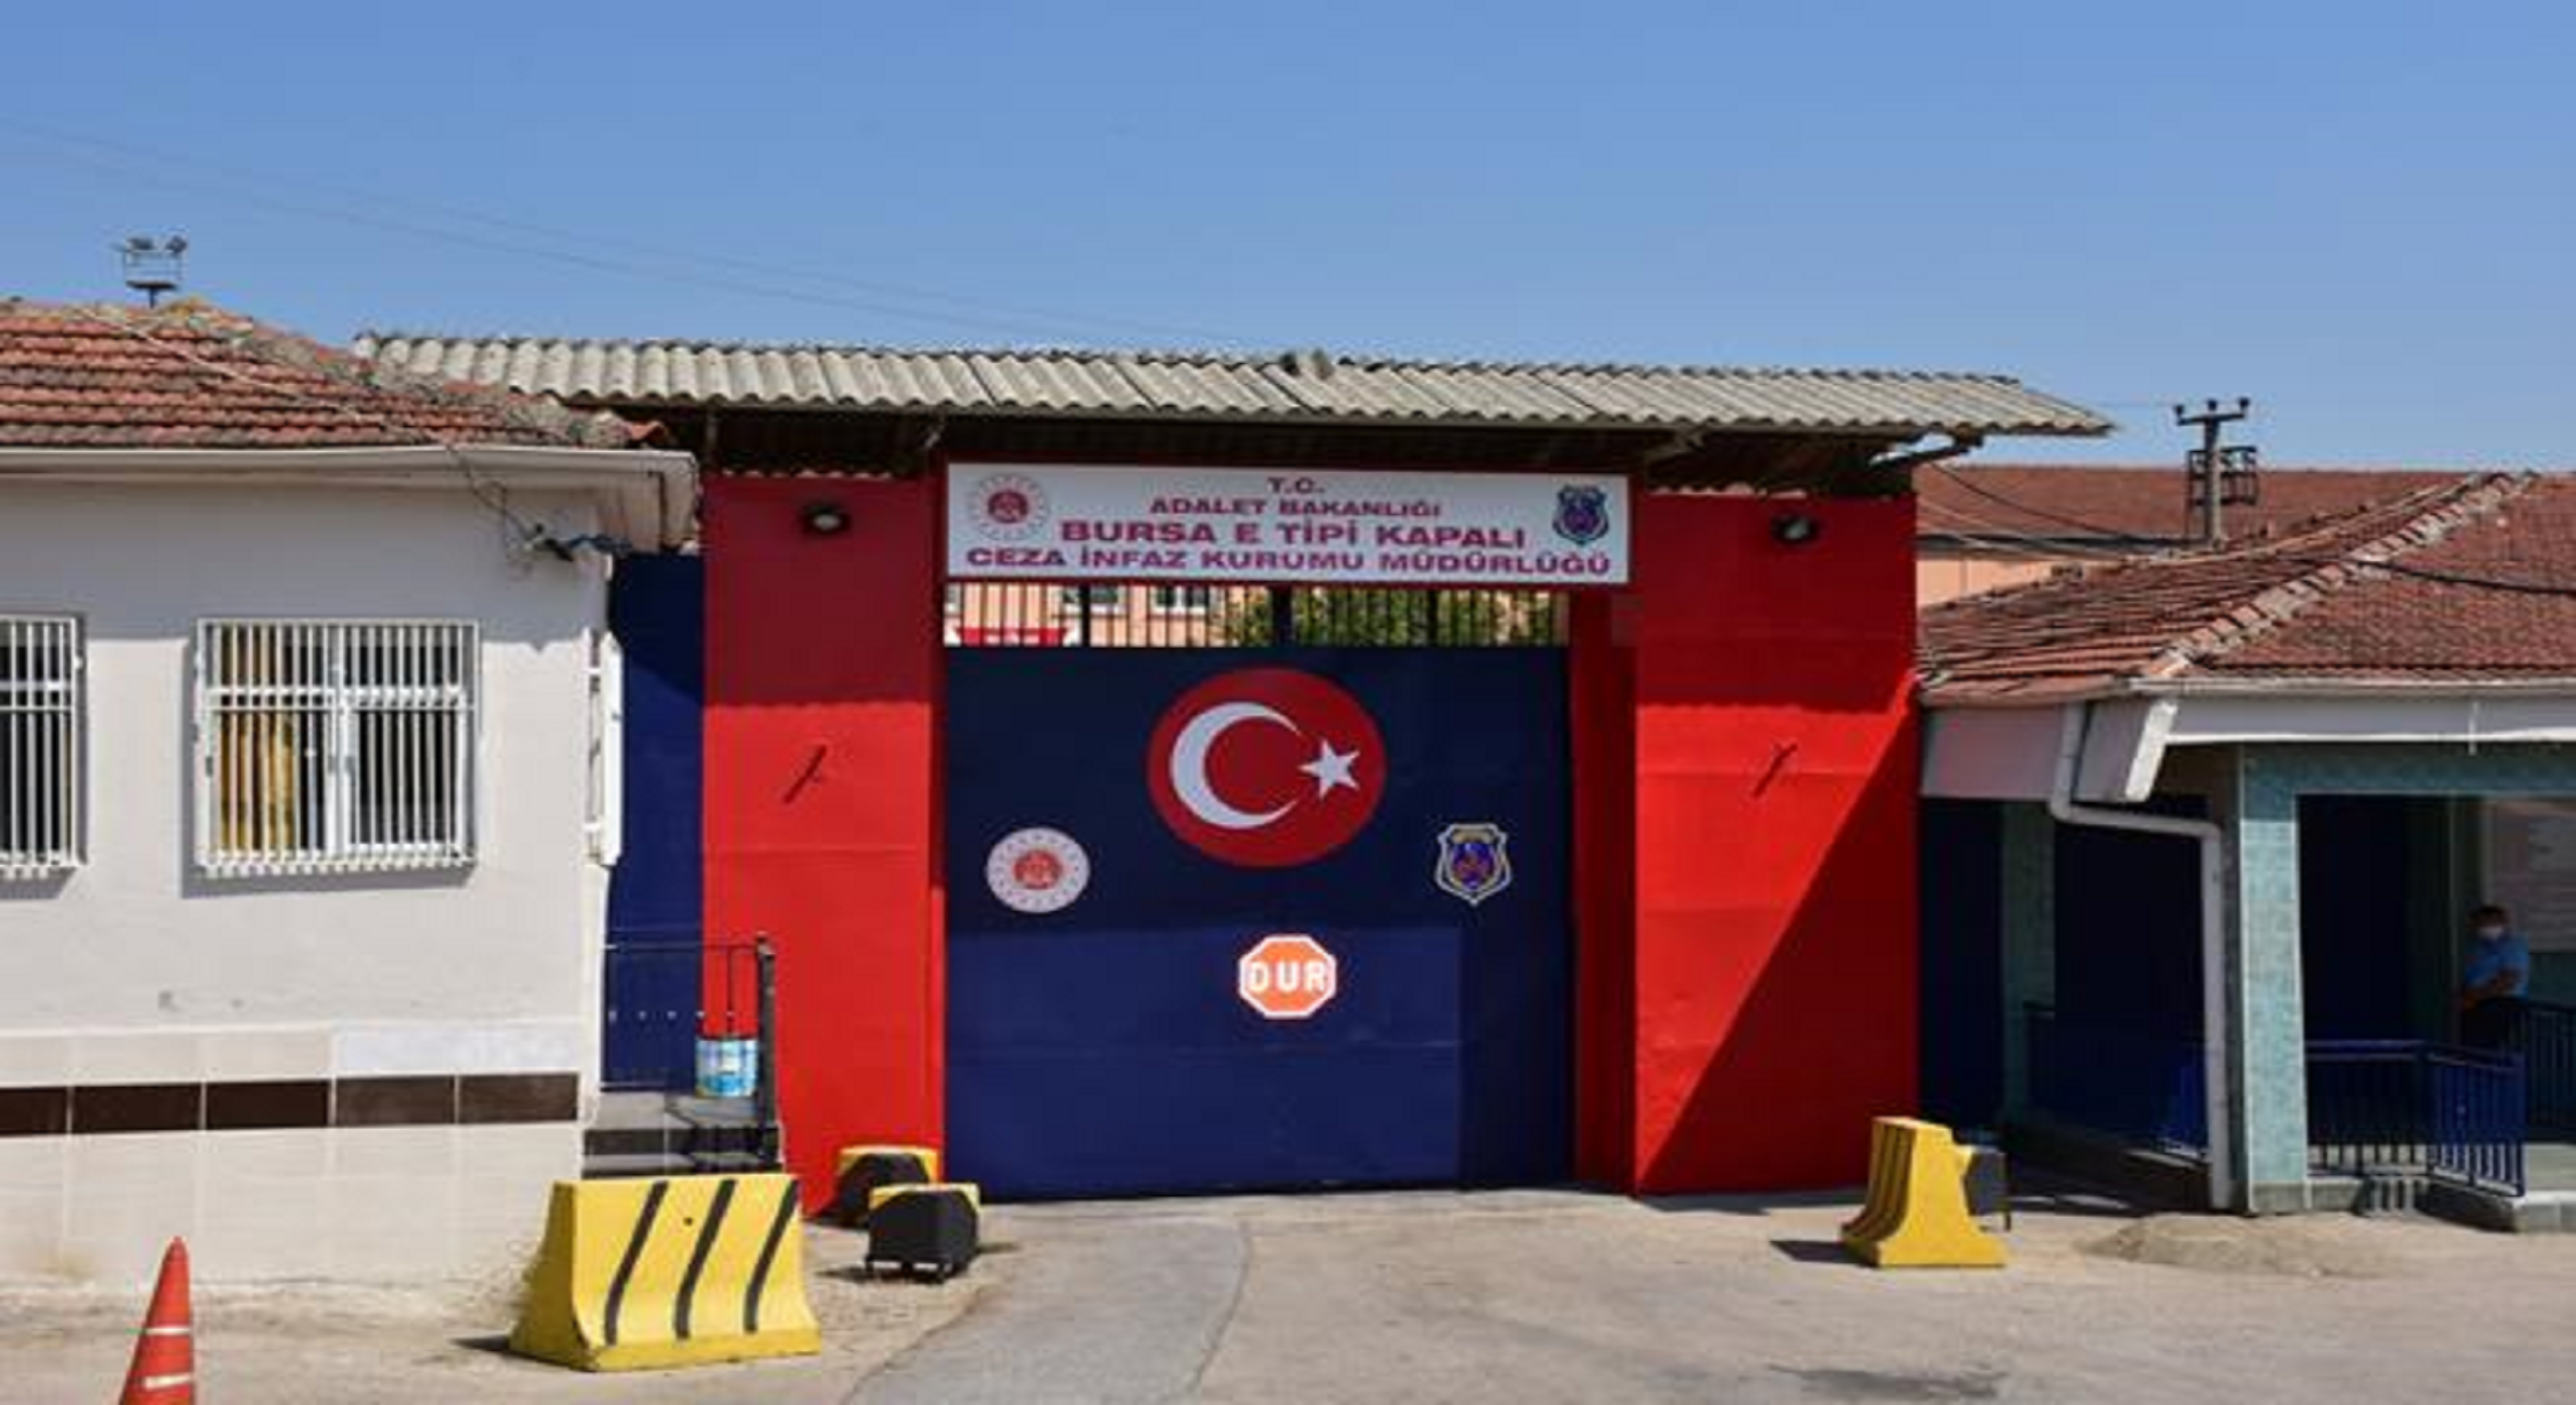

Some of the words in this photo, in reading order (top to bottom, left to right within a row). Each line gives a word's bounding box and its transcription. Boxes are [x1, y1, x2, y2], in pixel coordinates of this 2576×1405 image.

[1268, 477, 1325, 495] T.C.
[1150, 498, 1268, 515] ADALET
[1278, 499, 1442, 517] BAKANLIĞI
[1061, 520, 1218, 542] BURSA
[1237, 522, 1262, 544] E
[1277, 519, 1358, 546] TİPİ
[1375, 525, 1526, 549] KAPALI
[967, 548, 1067, 567] CEZA
[1080, 545, 1187, 569] İNFAZ
[1201, 550, 1364, 571] KURUMU
[1380, 551, 1612, 575] MÜDÜRLÜĞÜ
[1249, 960, 1326, 992] DUR
